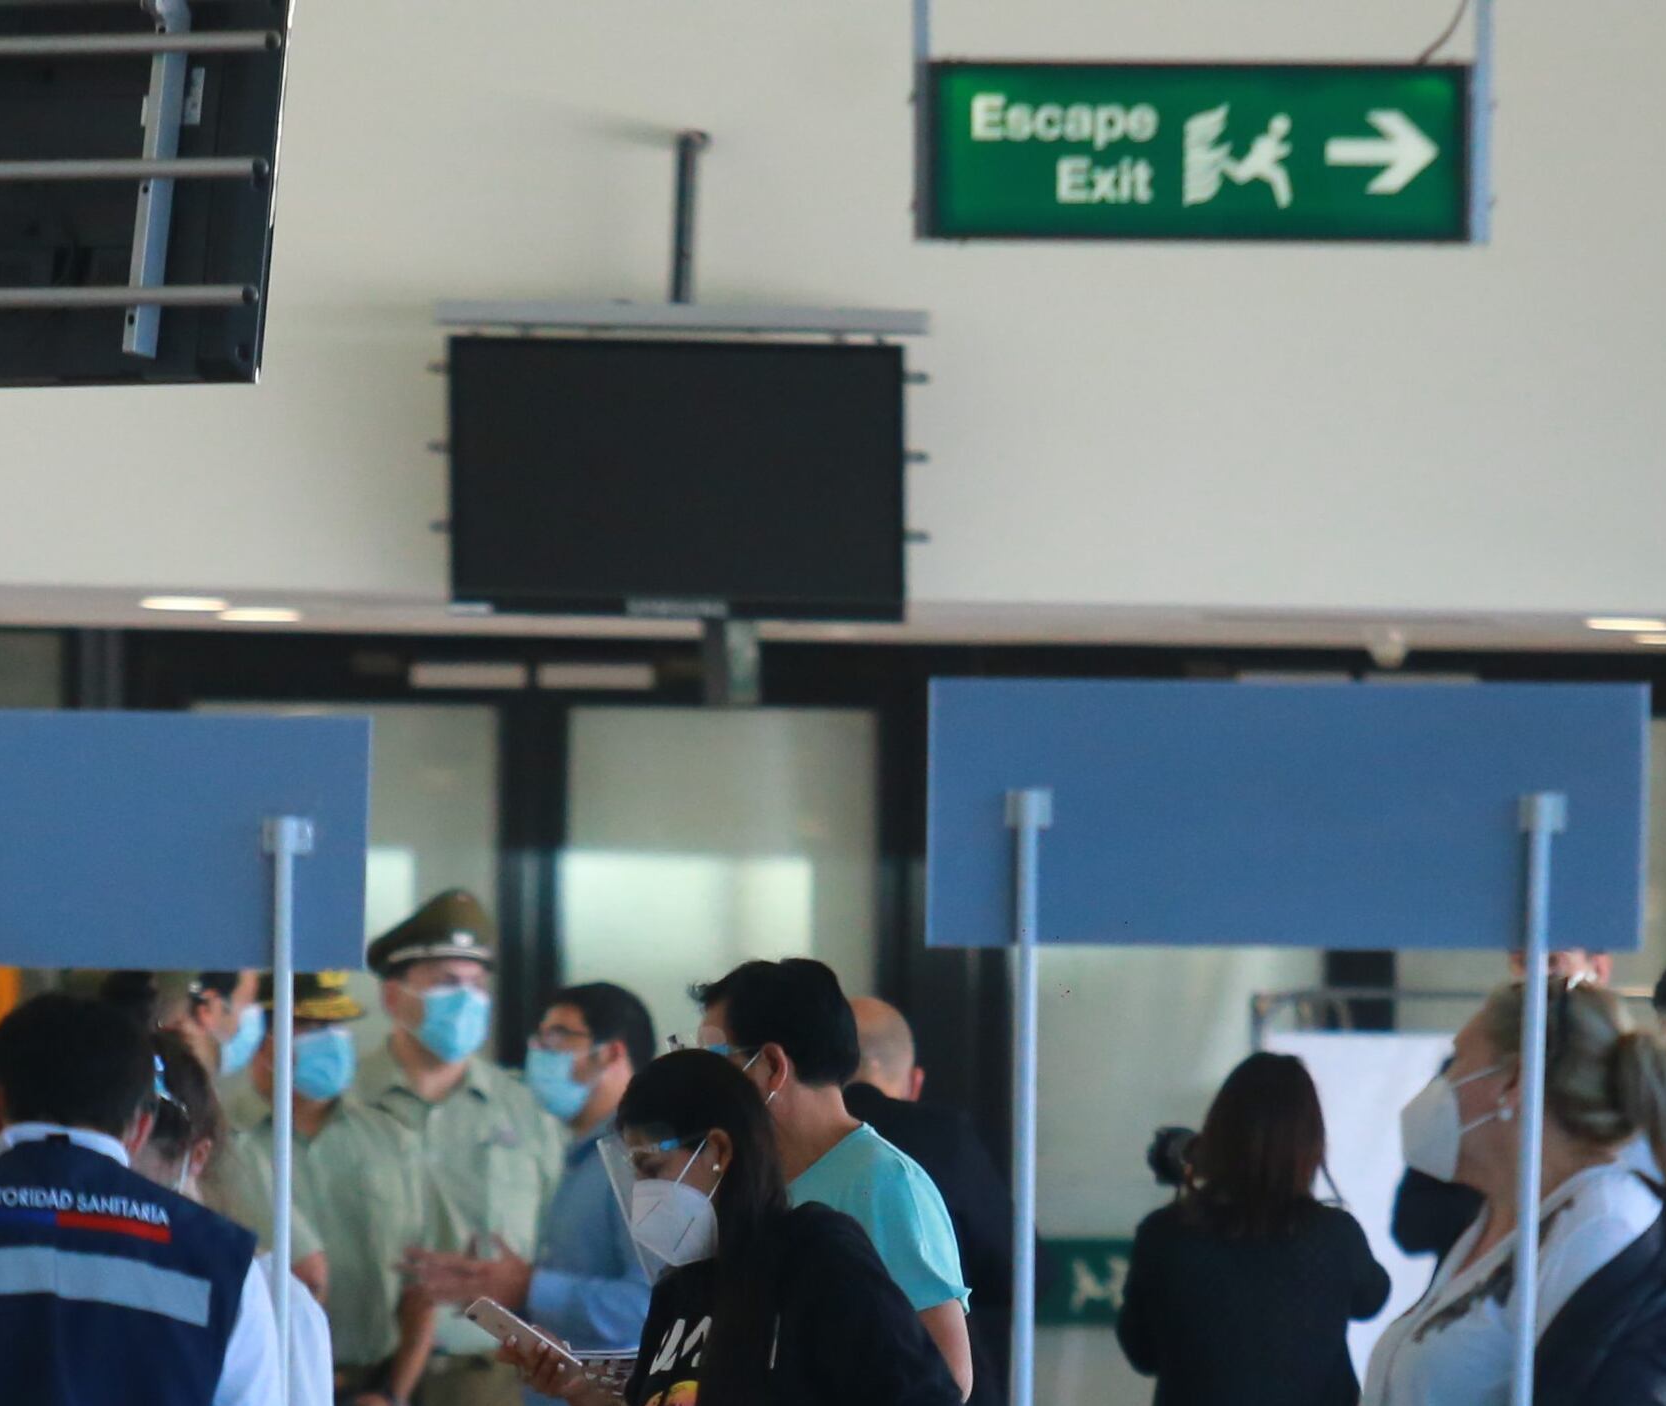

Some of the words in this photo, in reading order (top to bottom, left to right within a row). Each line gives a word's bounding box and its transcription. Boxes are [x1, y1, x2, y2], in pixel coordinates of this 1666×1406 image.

[970, 92, 1159, 150] Escape
[1055, 155, 1154, 204] Exit
[77, 1192, 170, 1225] SANITARIA
